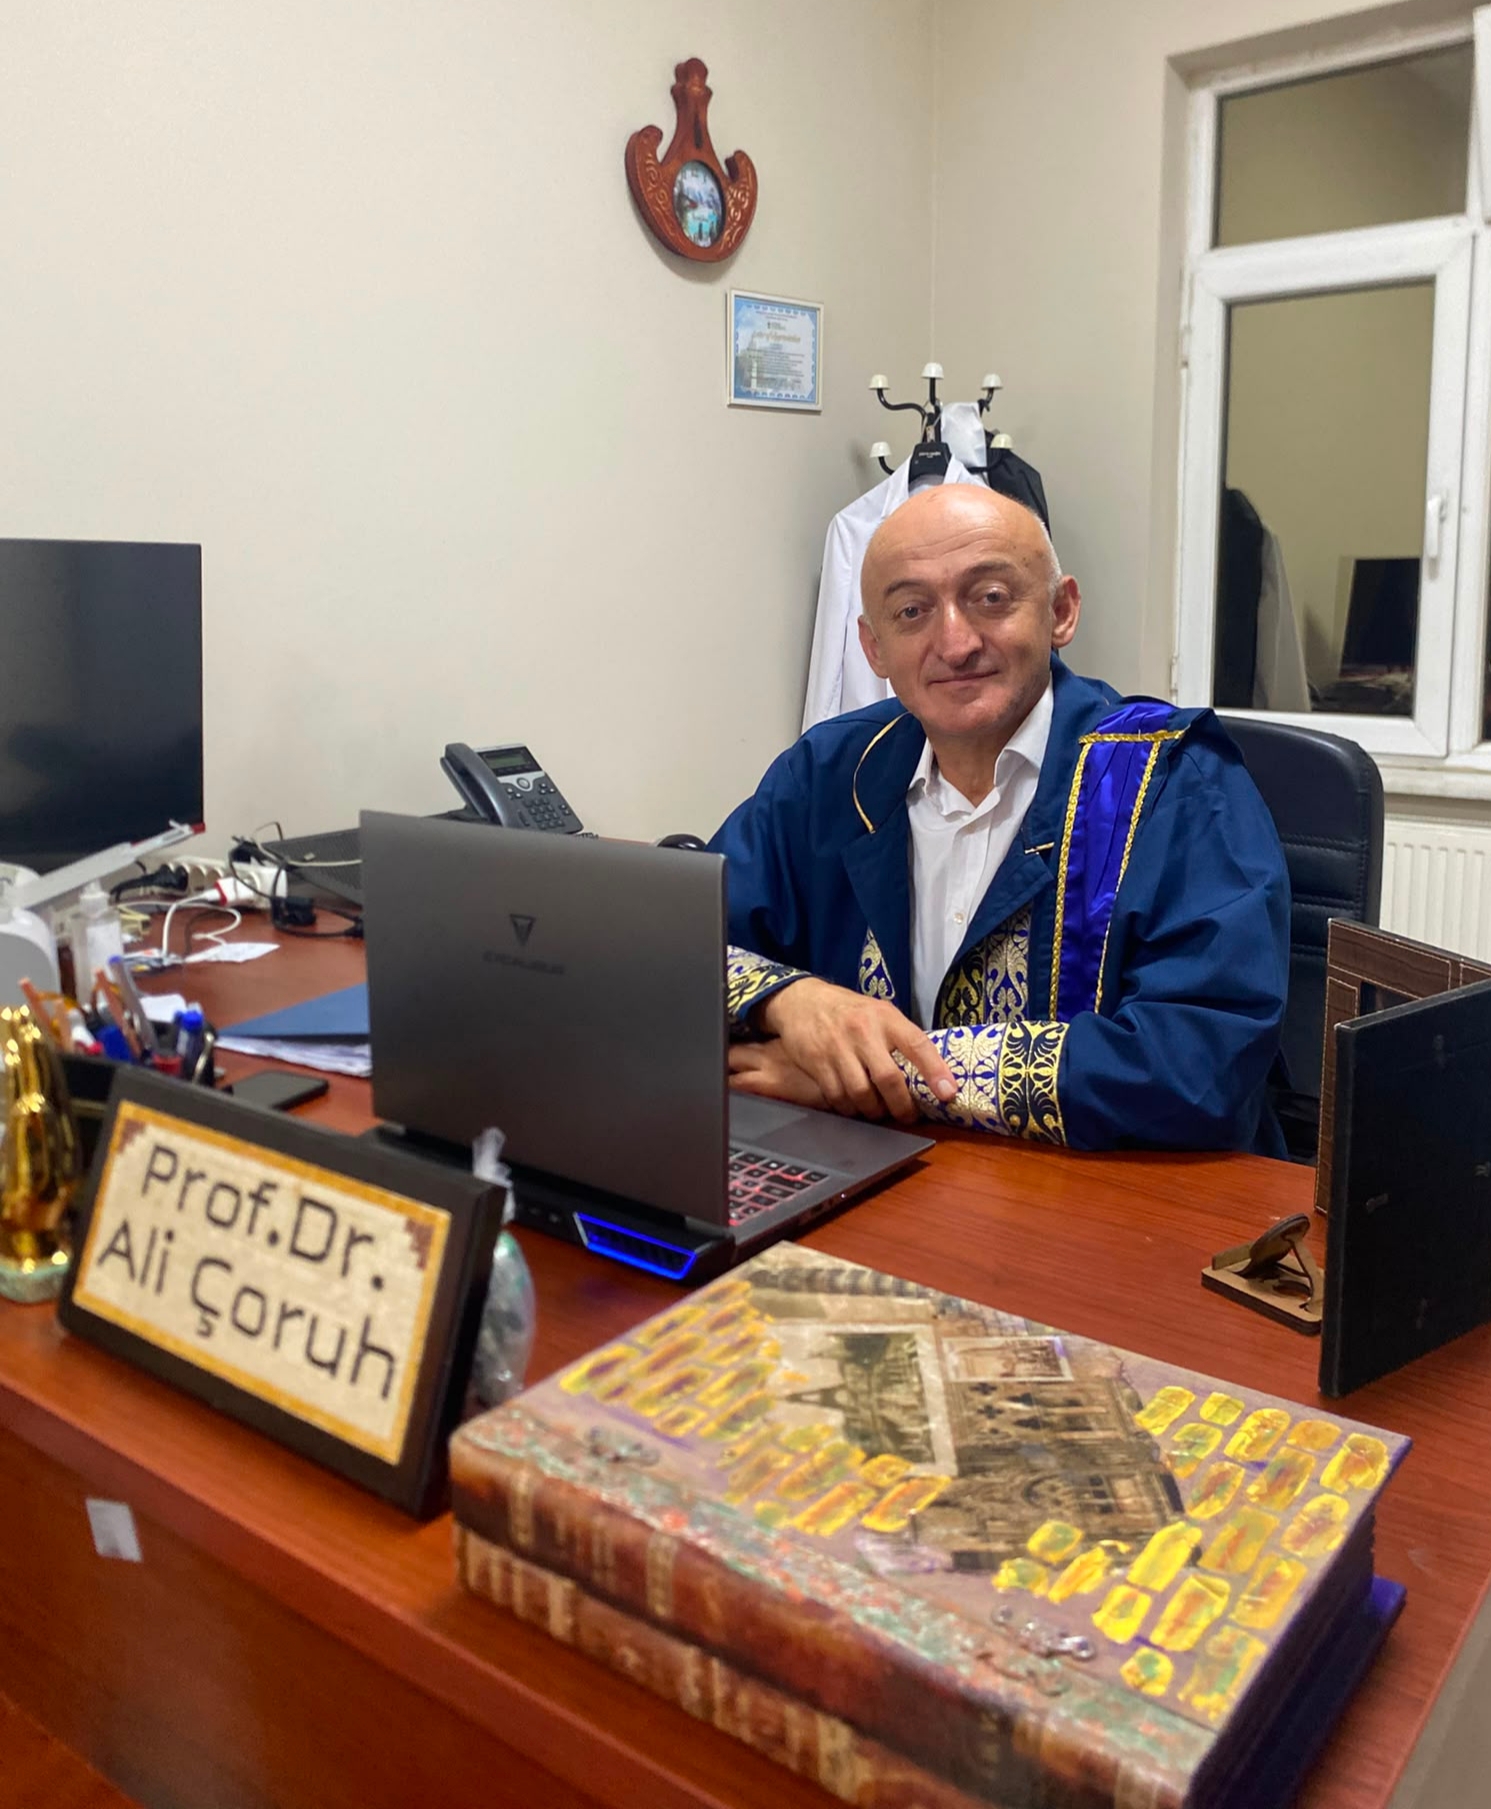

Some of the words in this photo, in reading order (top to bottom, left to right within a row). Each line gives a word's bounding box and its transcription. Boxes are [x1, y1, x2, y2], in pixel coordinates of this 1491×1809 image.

[141, 1144, 385, 1291] Prof.Dr.
[97, 1219, 174, 1295] Ali
[190, 1257, 397, 1400] Çoruh
